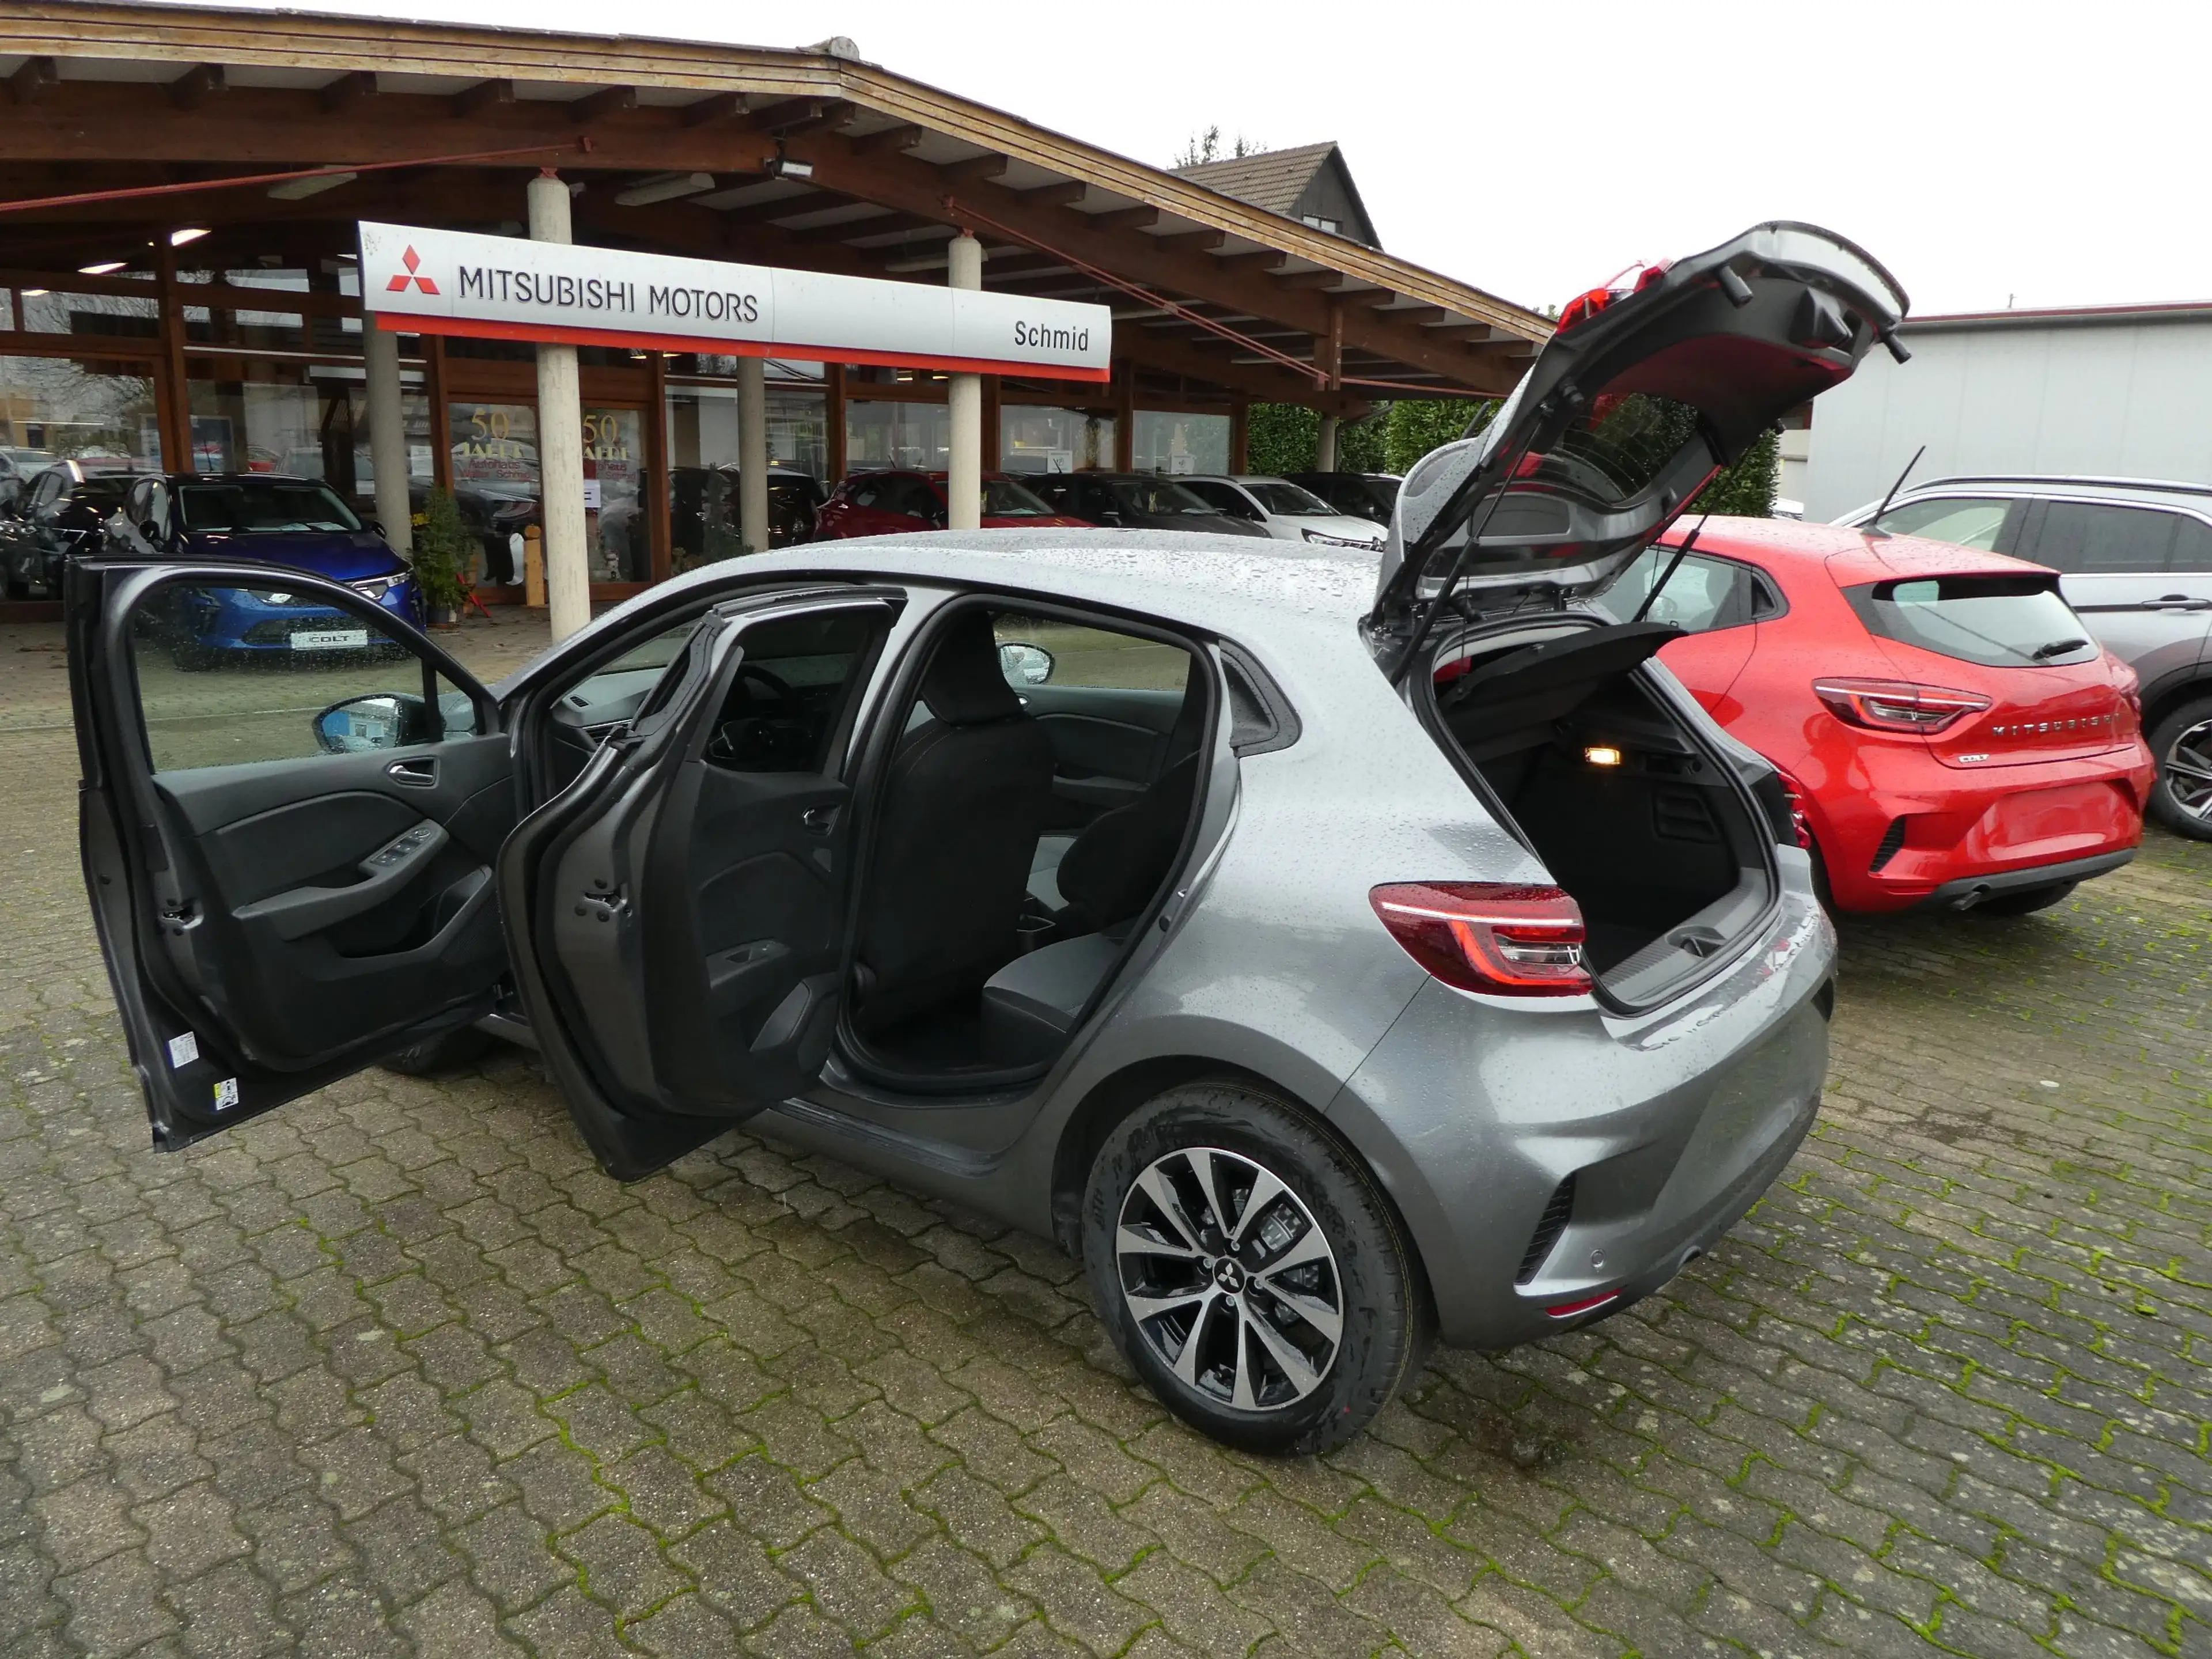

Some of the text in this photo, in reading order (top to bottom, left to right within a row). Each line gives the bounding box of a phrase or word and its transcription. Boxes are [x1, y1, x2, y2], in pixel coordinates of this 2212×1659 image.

[459, 266, 1089, 352] MITSUBISHI MOTORS Schmid
[471, 407, 509, 441] 50
[583, 414, 618, 443] 50
[582, 446, 632, 460] AHRE
